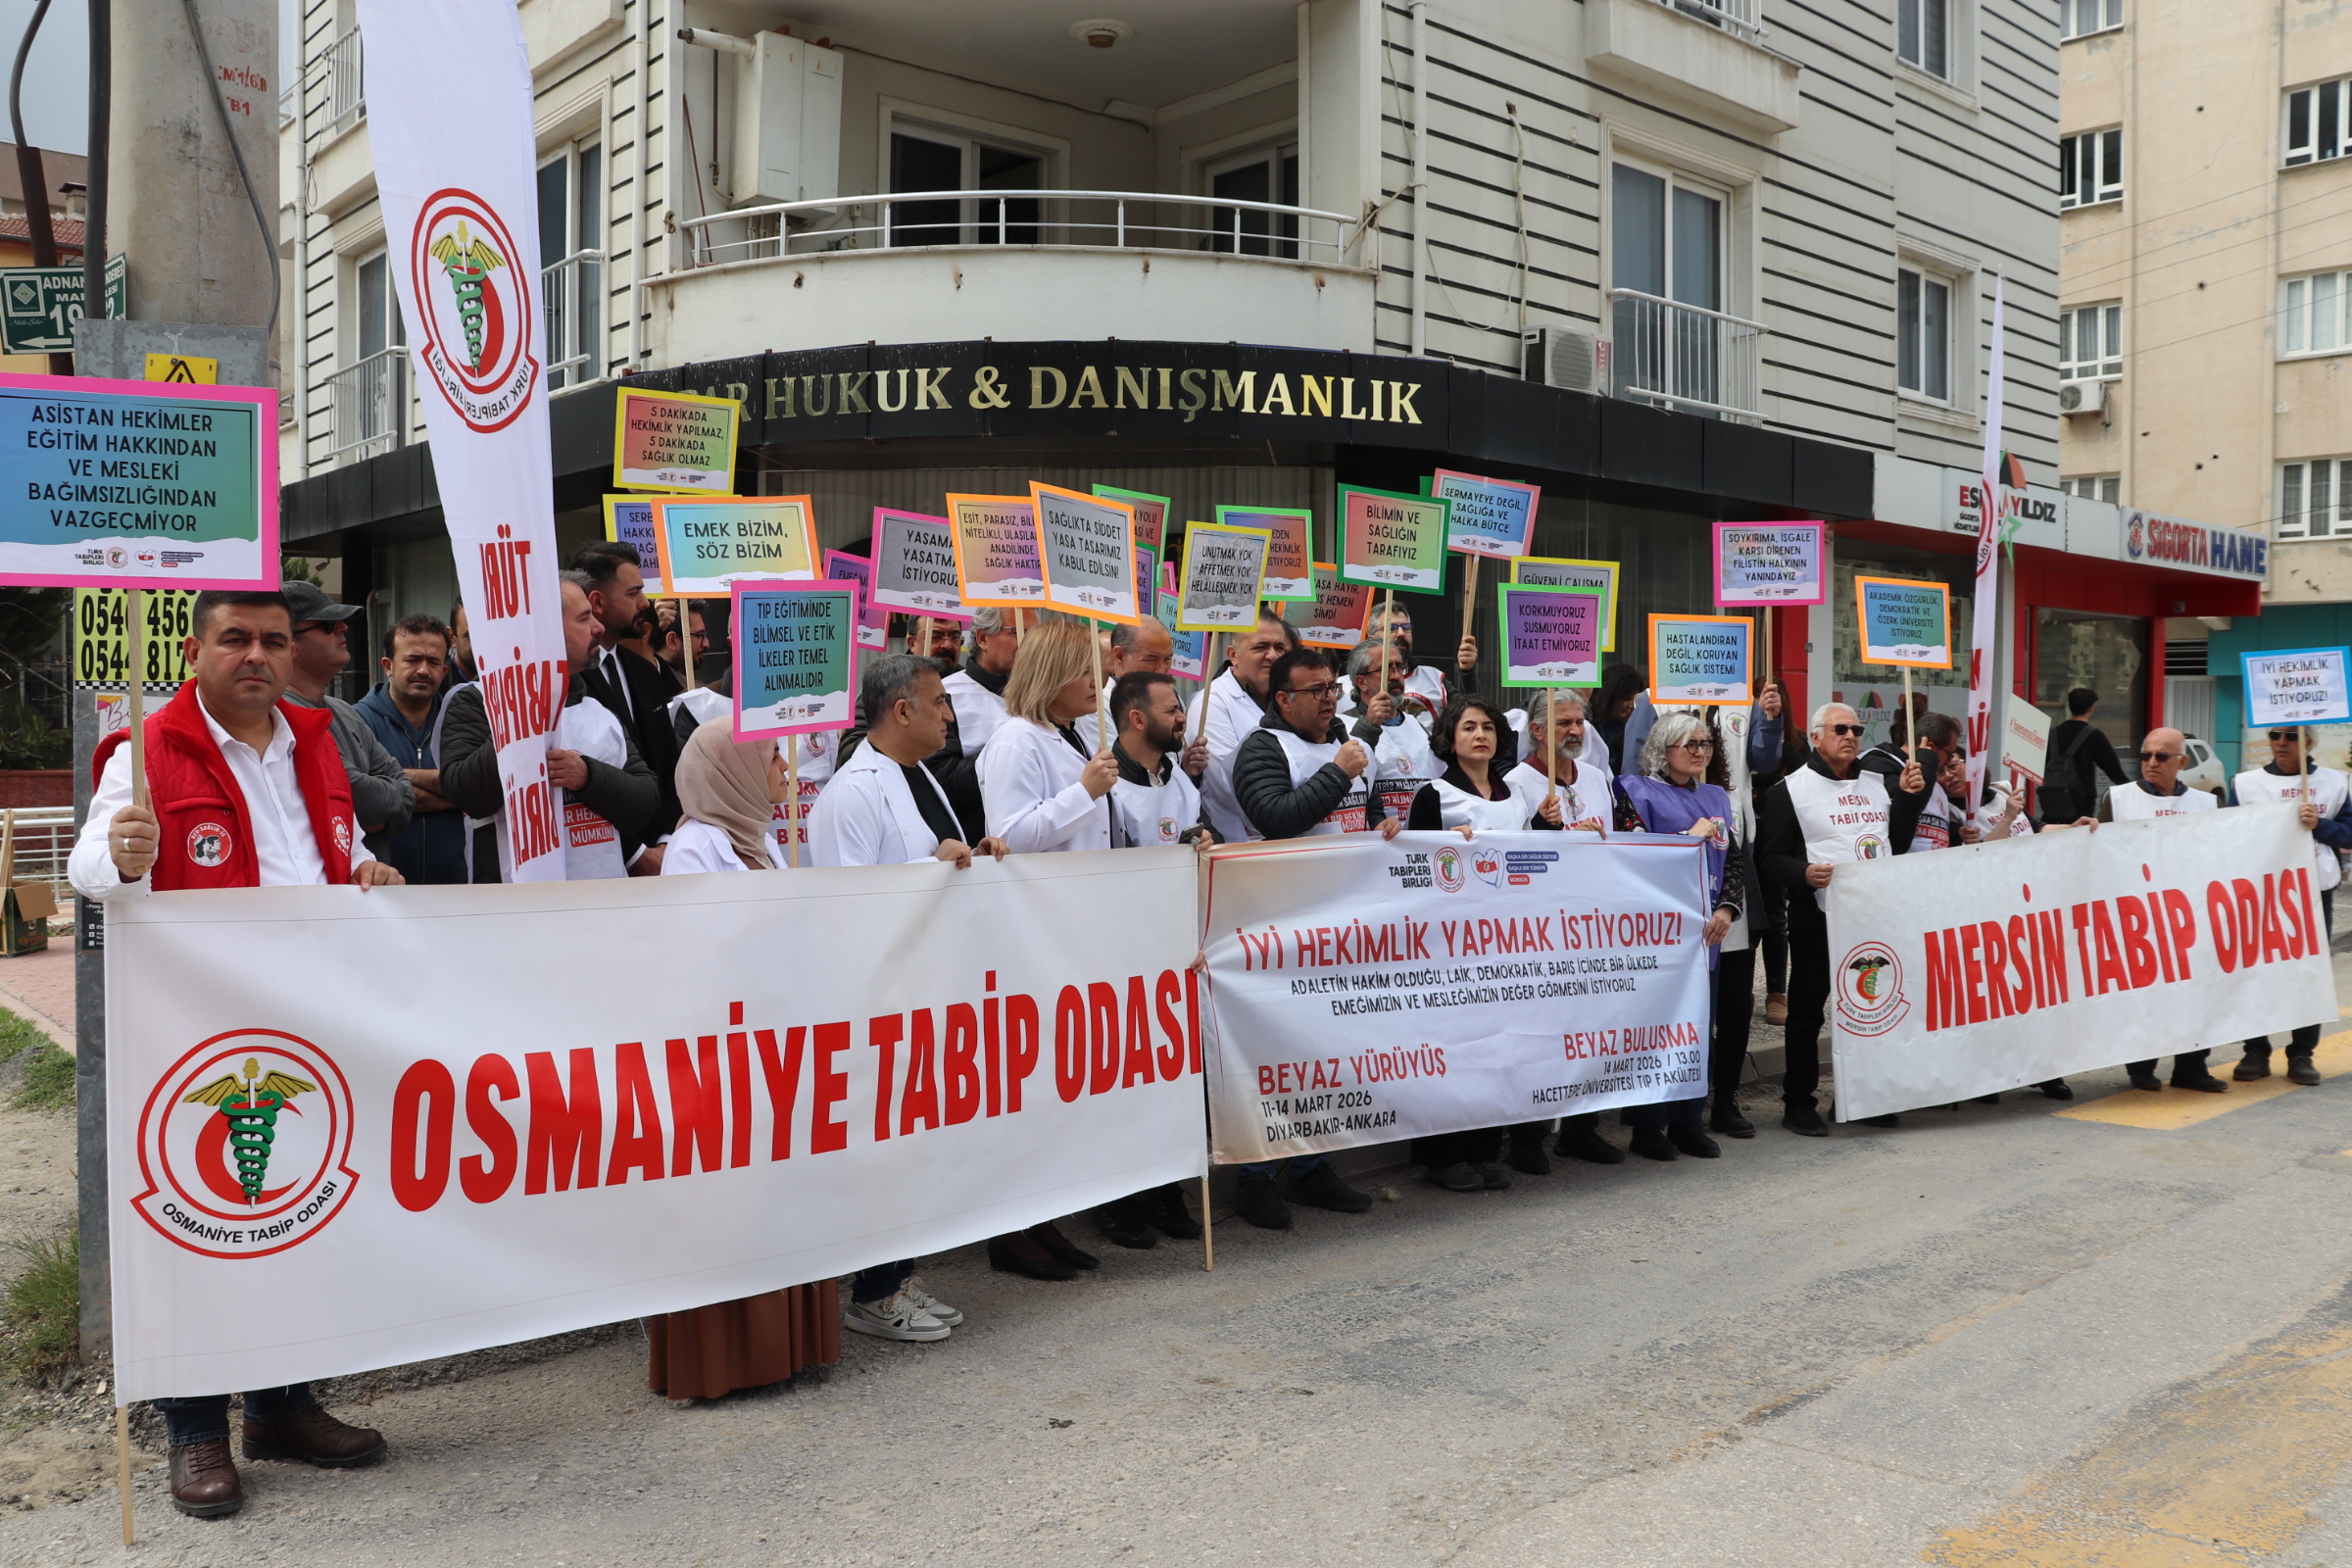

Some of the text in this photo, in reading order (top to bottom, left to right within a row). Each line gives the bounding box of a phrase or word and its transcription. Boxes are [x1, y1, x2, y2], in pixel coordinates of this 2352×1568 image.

[764, 366, 954, 419] HUKUK
[967, 366, 1011, 409] &
[1029, 366, 1423, 425] DANIŞMANLIK
[31, 403, 213, 432] ASİSTAN HEKİMLER
[651, 407, 707, 422] 5 DAKİKADA
[631, 418, 724, 440] HEKİMLİK YAPILMAZ,
[27, 428, 217, 458] EĞİTİM HAKKINDAN
[649, 436, 706, 451] 5 DAKİKADA
[642, 450, 710, 466] SAĞLIK OLMAZ
[69, 459, 179, 480] VE MESLEKİ
[28, 480, 217, 508] BAĞIMSIZLIĞINDAN
[1445, 488, 1524, 512] SERMAYEYE DEĞİL,
[1139, 511, 1156, 523] YOLU
[1366, 504, 1420, 524] BİLİMİN VE
[1456, 503, 1509, 520] SAĞLIĞA VE
[2011, 495, 2057, 523] YILDIZ
[50, 509, 197, 532] VAZGEÇMİYOR
[684, 519, 788, 538] EMEK BİZİM,
[963, 513, 1019, 527] EŞİT, PARASIZ,
[1049, 510, 1092, 533] SAĞLIKTA
[1094, 521, 1121, 541] ŞİDDET
[1451, 514, 1510, 533] HALKA BÜTÇE
[965, 527, 1003, 542] NİTELİKLİ,
[1146, 527, 1154, 539] VE
[1368, 523, 1417, 542] SAĞLIĞIN
[1728, 532, 1811, 544] SOYKIRIMA, İŞGALE
[696, 541, 782, 559] SÖZ BİZİM
[990, 543, 1034, 556] ANADİLİNDE
[1053, 531, 1121, 561] YASA TASARIMIZ
[1201, 545, 1252, 562] UNUTMAK YOK
[1367, 542, 1417, 560] TARAFIYIZ
[1739, 545, 1801, 556] KARŞI DİRENEN
[2210, 529, 2268, 575] HANE
[985, 557, 1012, 568] SAĞLIK
[1058, 553, 1119, 580] KABUL EDİLSİN!
[1199, 563, 1250, 578] AFFETMEK YOK
[1734, 558, 1807, 569] FİLİSTİN HALKININ
[1744, 571, 1796, 581] YANINDAYIZ
[1192, 579, 1253, 596] HELALLEŞMEK YOK
[1334, 580, 1360, 594] HAYIR,
[1326, 595, 1354, 608] HEMEN
[1869, 591, 1902, 602] AKADEMİK
[758, 599, 831, 619] TIP EĞİTİMİNDE
[1313, 607, 1337, 620] ŞİMDİ
[1519, 604, 1586, 619] KORKMUYORUZ
[1880, 604, 1920, 615] DEMOKRATİK
[1524, 621, 1581, 635] SUSMUYORUZ
[1877, 615, 1935, 628] ÖZERK ÜNİVERSİTE
[754, 622, 835, 644] BİLİMSEL VE ETİK
[1666, 634, 1738, 646] HASTALANDIRAN
[1890, 627, 1923, 638] İSTİYORUZ
[1514, 636, 1591, 653] İTAAT ETMİYORUZ
[759, 648, 829, 667] İLKELER TEMEL
[1666, 648, 1739, 661] DEĞİL, KORUYAN
[1669, 662, 1736, 674] SAĞLIK SİSTEMİ
[2262, 658, 2328, 674] İYİ HEKİMLİK
[764, 671, 823, 691] ALINMALIDIR
[2274, 675, 2321, 689] YAPMAK
[2270, 689, 2328, 706] İSTİYORUZ!
[1389, 865, 1431, 877] TABİPLERİ
[1402, 877, 1433, 888] BİRLİĞİ
[1236, 907, 1683, 971] İYİ HEKİMLİK YAPMAK İSTİYORUZ!
[1923, 862, 2320, 1032] MERSİN TABİP ODASI
[1291, 955, 1659, 996] ADALETİN HAKİM OLDUĞU, LAİK, DEMOKRATİK, BARIŞ İÇİNDE BİR ÜLKEDE
[1331, 974, 1636, 1016] EMEĞİMİZİN VE MESLEĞİMİZİN DEĞER GÖRMESİNİ İSTİYORUZ
[1845, 1020, 1867, 1033] MERSİN
[1883, 1013, 1898, 1028] ODASI
[1564, 1021, 1699, 1060] BEYAZ BULUŞMA
[1258, 1043, 1446, 1096] BEYAZ YÜRÜYÜŞ
[1603, 1060, 1611, 1075] 14
[1612, 1057, 1635, 1073] MART
[1637, 1055, 1662, 1071] 2026
[1675, 1051, 1701, 1065] 13.00
[391, 967, 1202, 1213] OSMANİYE TABİP ODASI
[1533, 1084, 1580, 1104] HACETTEPE
[1582, 1076, 1635, 1096] ÜNİVERSİTESİ
[1637, 1075, 1652, 1089] TIP
[1261, 1090, 1372, 1118] 11-14 MART 2026
[1266, 1110, 1396, 1143] DİYARBAKIR-ANKARA
[162, 1180, 338, 1244] OSMANİYE TABİP ODASI
